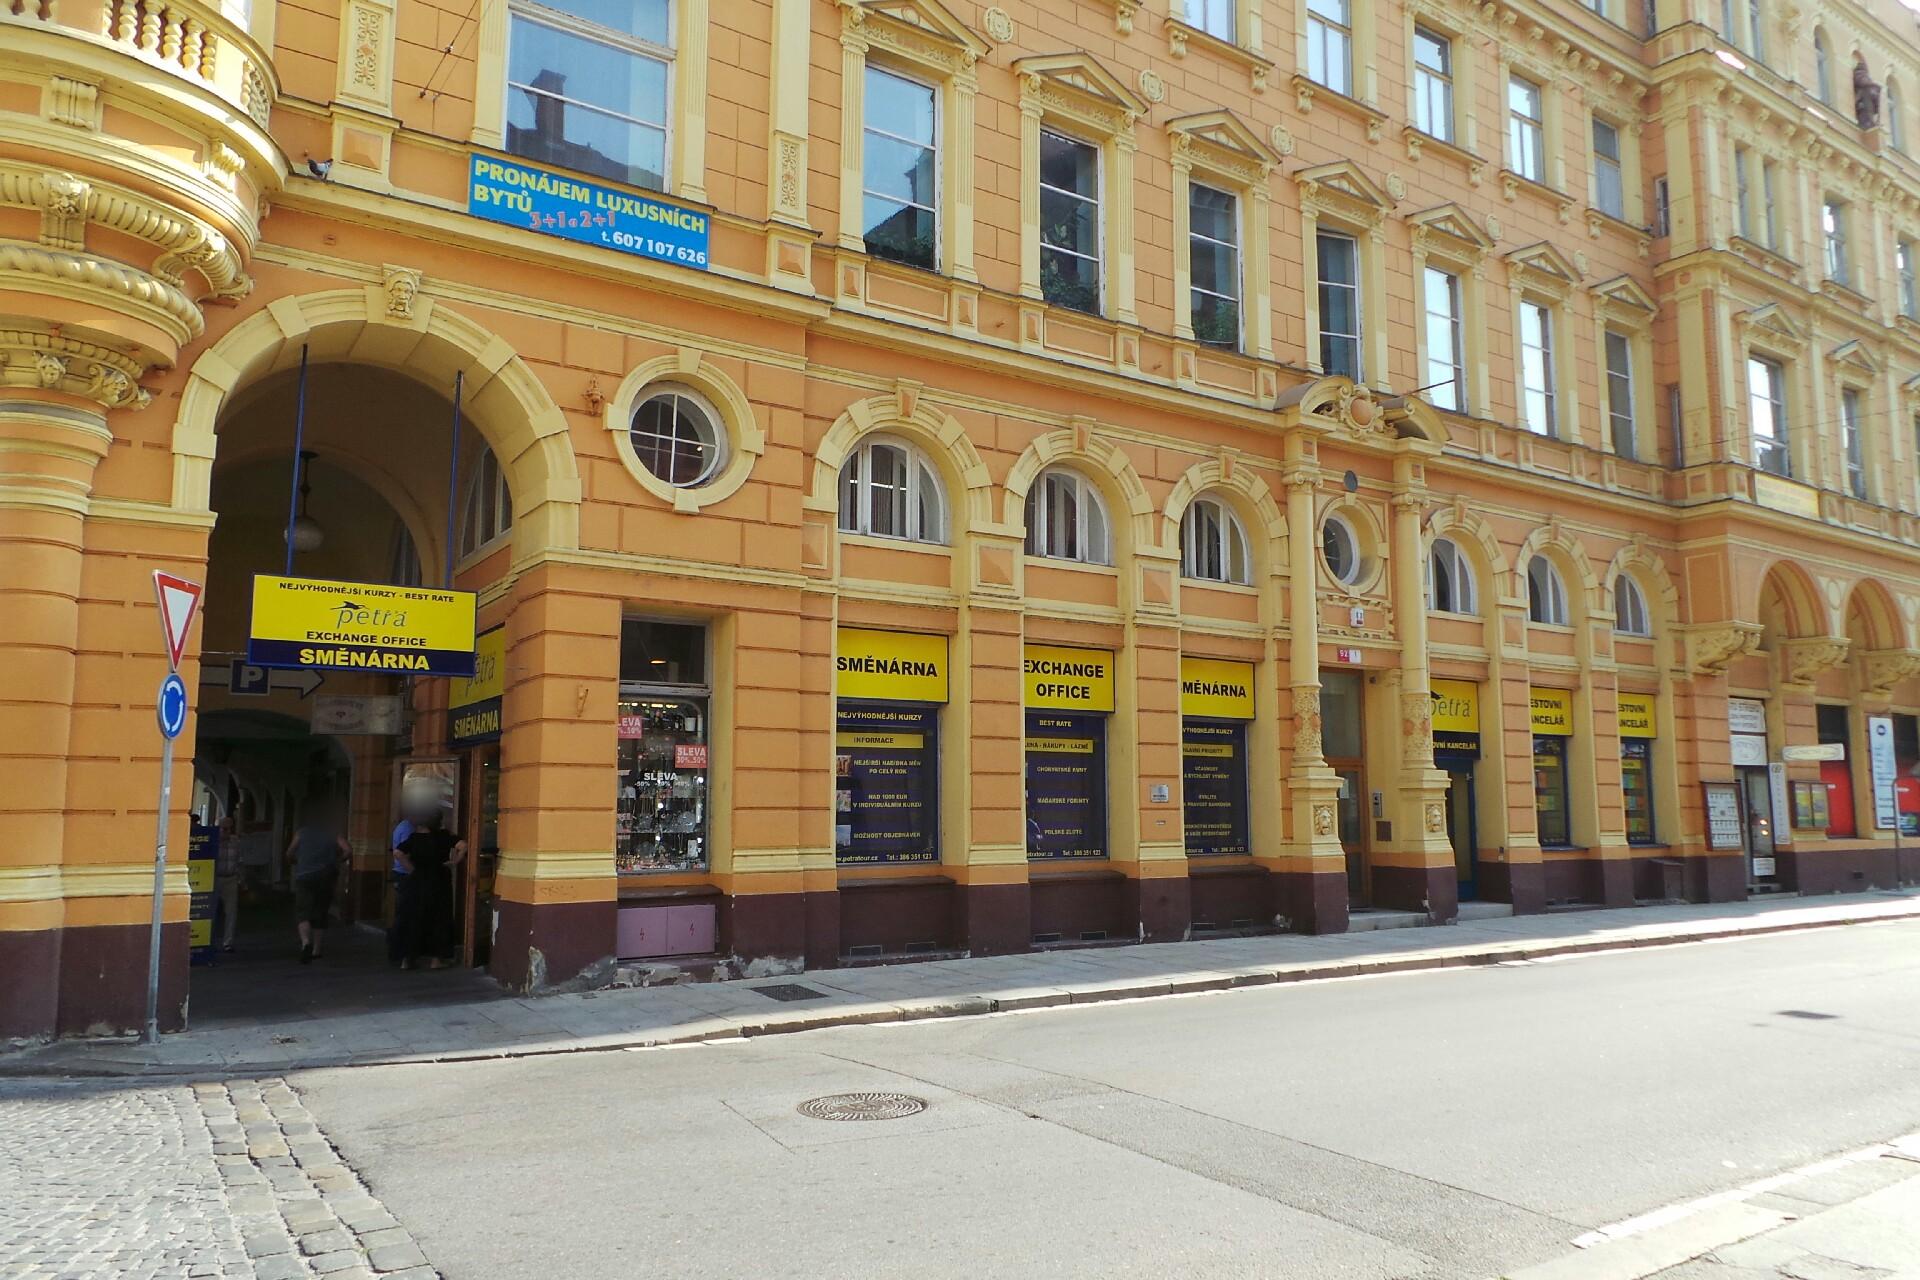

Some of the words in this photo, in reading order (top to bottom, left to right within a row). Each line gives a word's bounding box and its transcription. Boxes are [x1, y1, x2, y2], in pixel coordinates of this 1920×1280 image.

[474, 184, 532, 213] BYTŮ
[475, 160, 590, 204] PRONÁJEM
[596, 191, 705, 234] LUXUSNÍCH
[529, 211, 566, 229] 3+1
[579, 210, 616, 228] 2+1
[601, 230, 611, 243] t.
[613, 231, 643, 249] 607
[647, 239, 675, 257] 107
[677, 247, 706, 264] 626
[364, 589, 397, 598] KURZY
[405, 592, 429, 601] BEST
[431, 594, 455, 603] RATE
[306, 631, 378, 644] EXCHANGE
[382, 635, 427, 647] OFFICE
[299, 647, 430, 671] SMĚNÁRNA
[837, 655, 938, 677] SMĚNÁRNA
[241, 667, 265, 685] P
[1024, 659, 1104, 679] EXCHANGE
[1036, 683, 1090, 699] OFFICE
[454, 710, 499, 739] SMĚNÁRNA
[898, 713, 922, 721] KURZY
[677, 747, 706, 757] SLEVA
[643, 772, 678, 781] SLEVA
